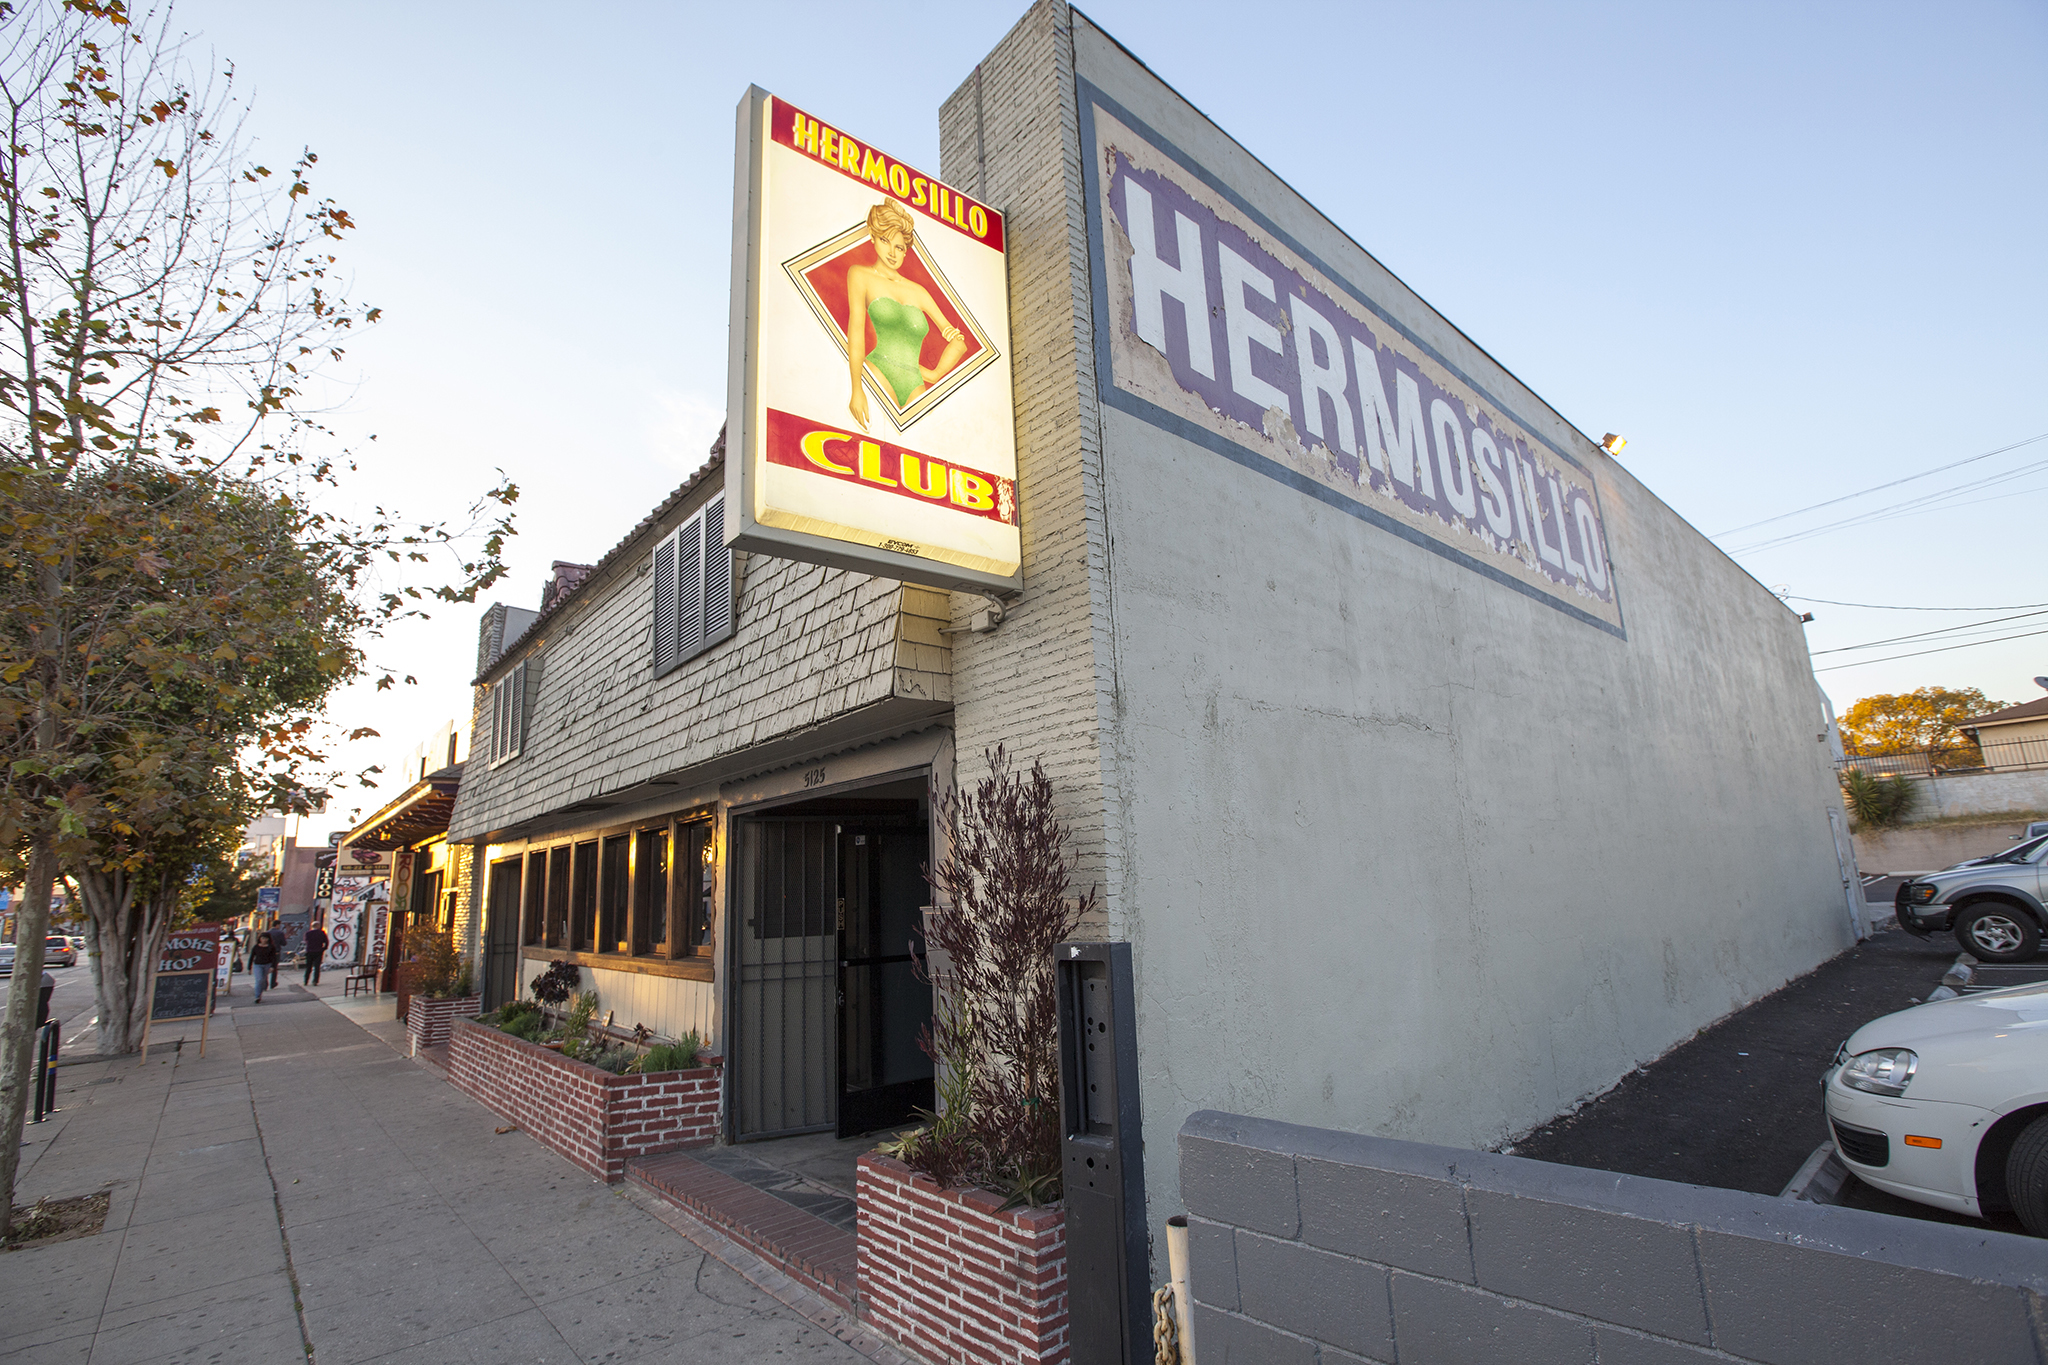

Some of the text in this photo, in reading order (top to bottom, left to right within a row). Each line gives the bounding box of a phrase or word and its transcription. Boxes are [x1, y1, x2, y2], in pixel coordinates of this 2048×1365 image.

[792, 111, 988, 239] HERMOSILLO
[1123, 175, 1606, 592] HERMOSILLO
[800, 430, 997, 512] CLUB
[803, 766, 826, 788] 5125
[318, 867, 334, 897] TTOO
[163, 938, 215, 953] MOKE
[158, 955, 202, 971] HOP
